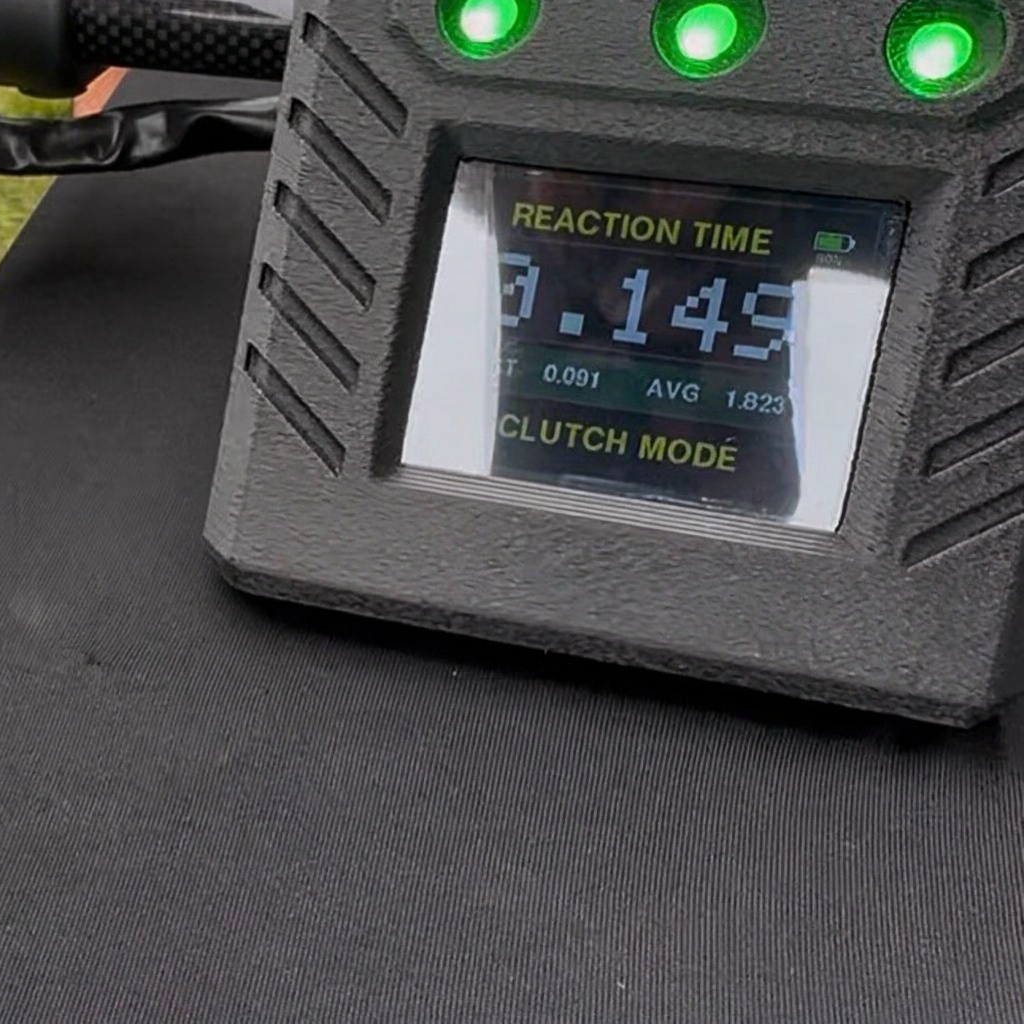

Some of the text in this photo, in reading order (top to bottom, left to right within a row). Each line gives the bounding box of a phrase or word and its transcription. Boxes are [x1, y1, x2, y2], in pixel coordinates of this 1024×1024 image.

[511, 202, 774, 256] REACTION TIME
[499, 252, 796, 361] 0.149
[542, 363, 601, 389] 0.091
[645, 378, 701, 404] AVG
[726, 389, 786, 416] 1.823
[498, 413, 739, 473] CLUTCH MODE
